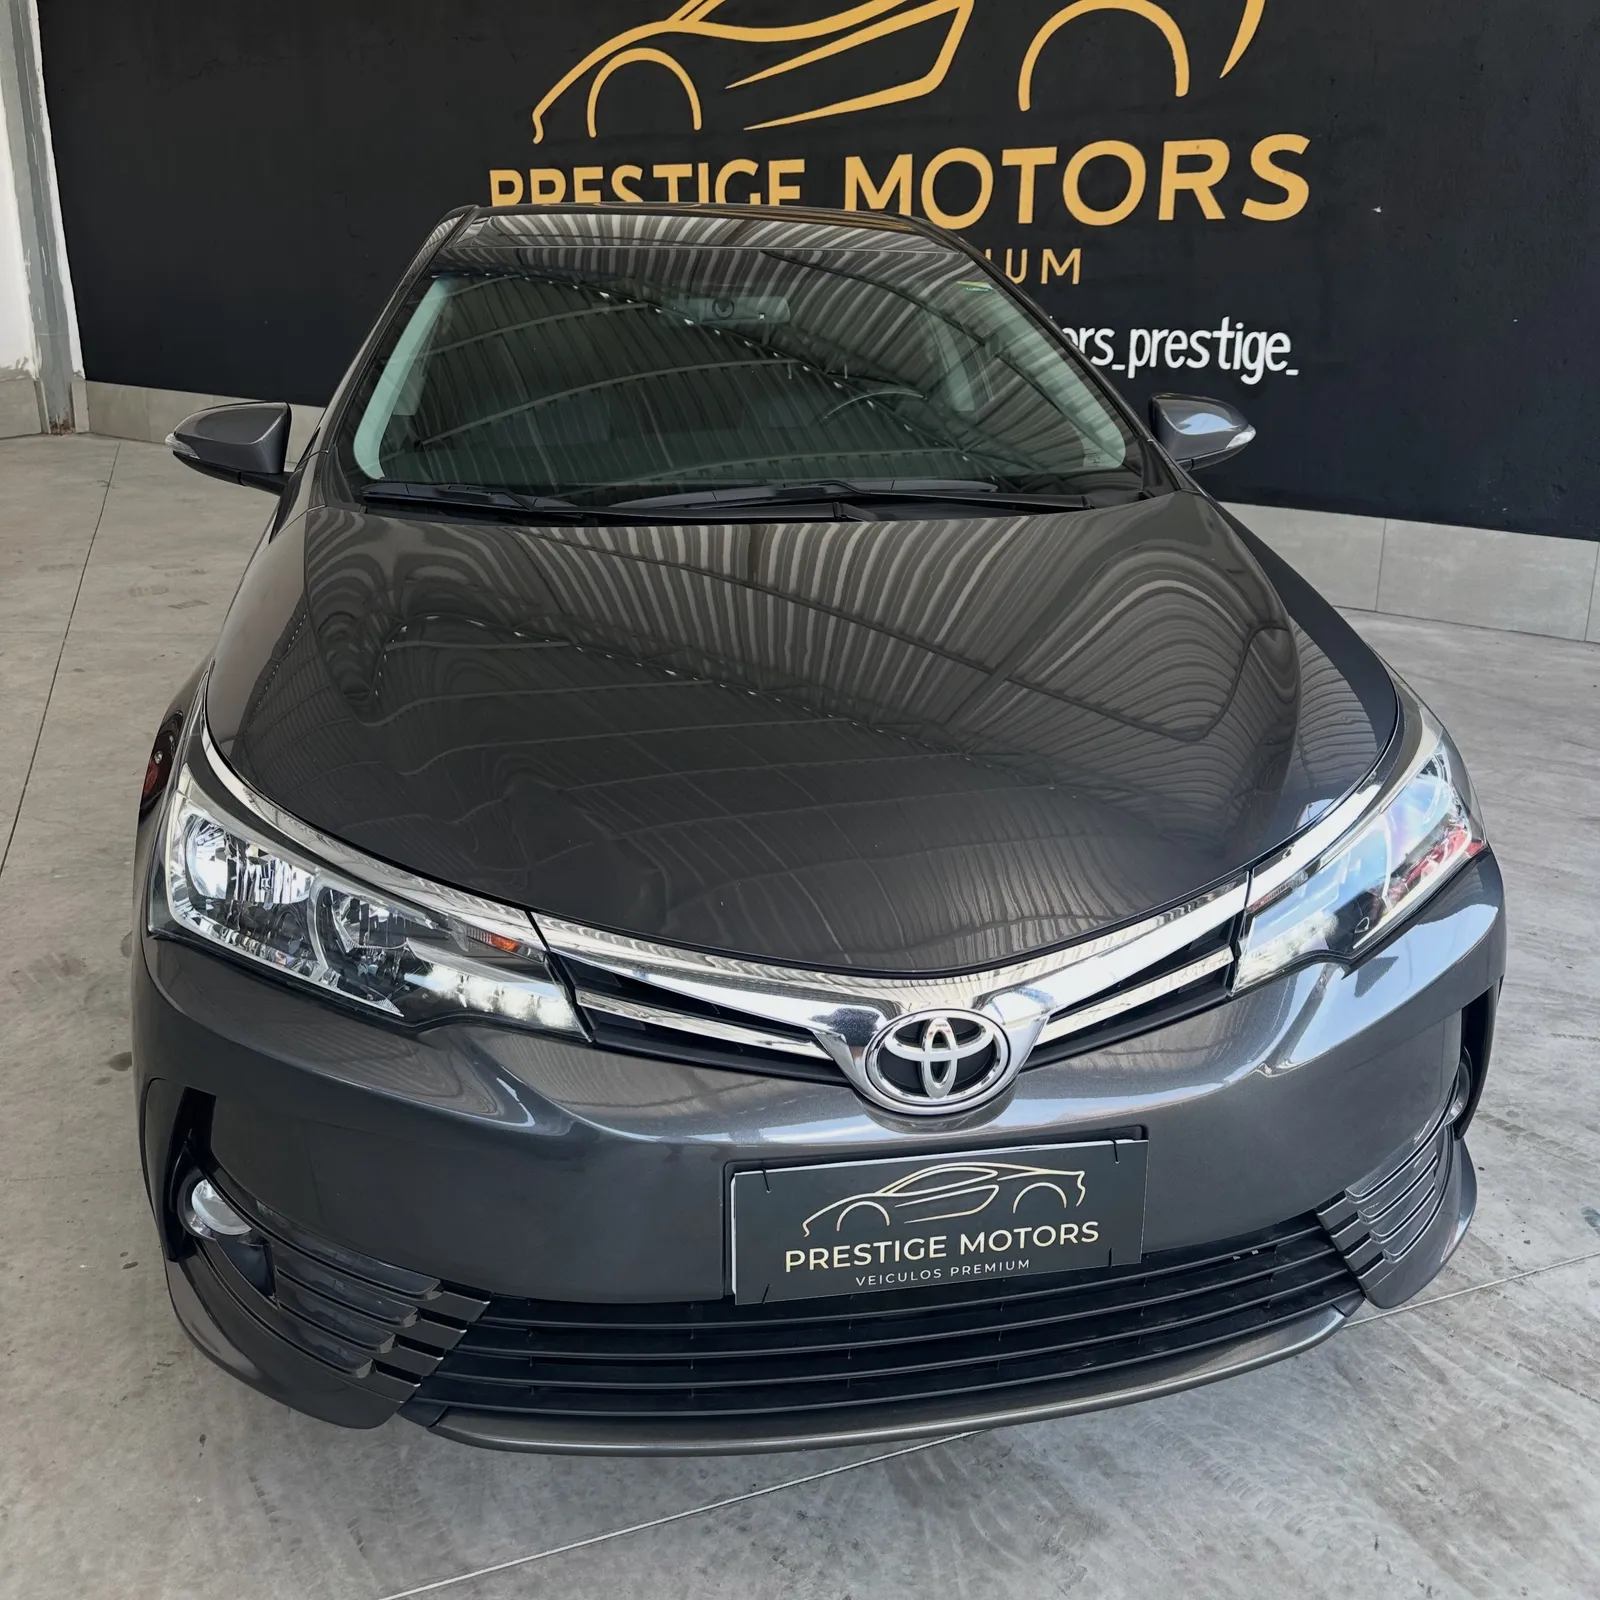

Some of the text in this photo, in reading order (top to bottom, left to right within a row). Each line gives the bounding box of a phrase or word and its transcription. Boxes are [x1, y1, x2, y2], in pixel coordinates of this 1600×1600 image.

[489, 133, 1311, 230] PRESTIGE MOTORS
[785, 1221, 1100, 1273] PRESTIGE MOTORS
[855, 1259, 1030, 1287] VEICULOS PREMIUM
